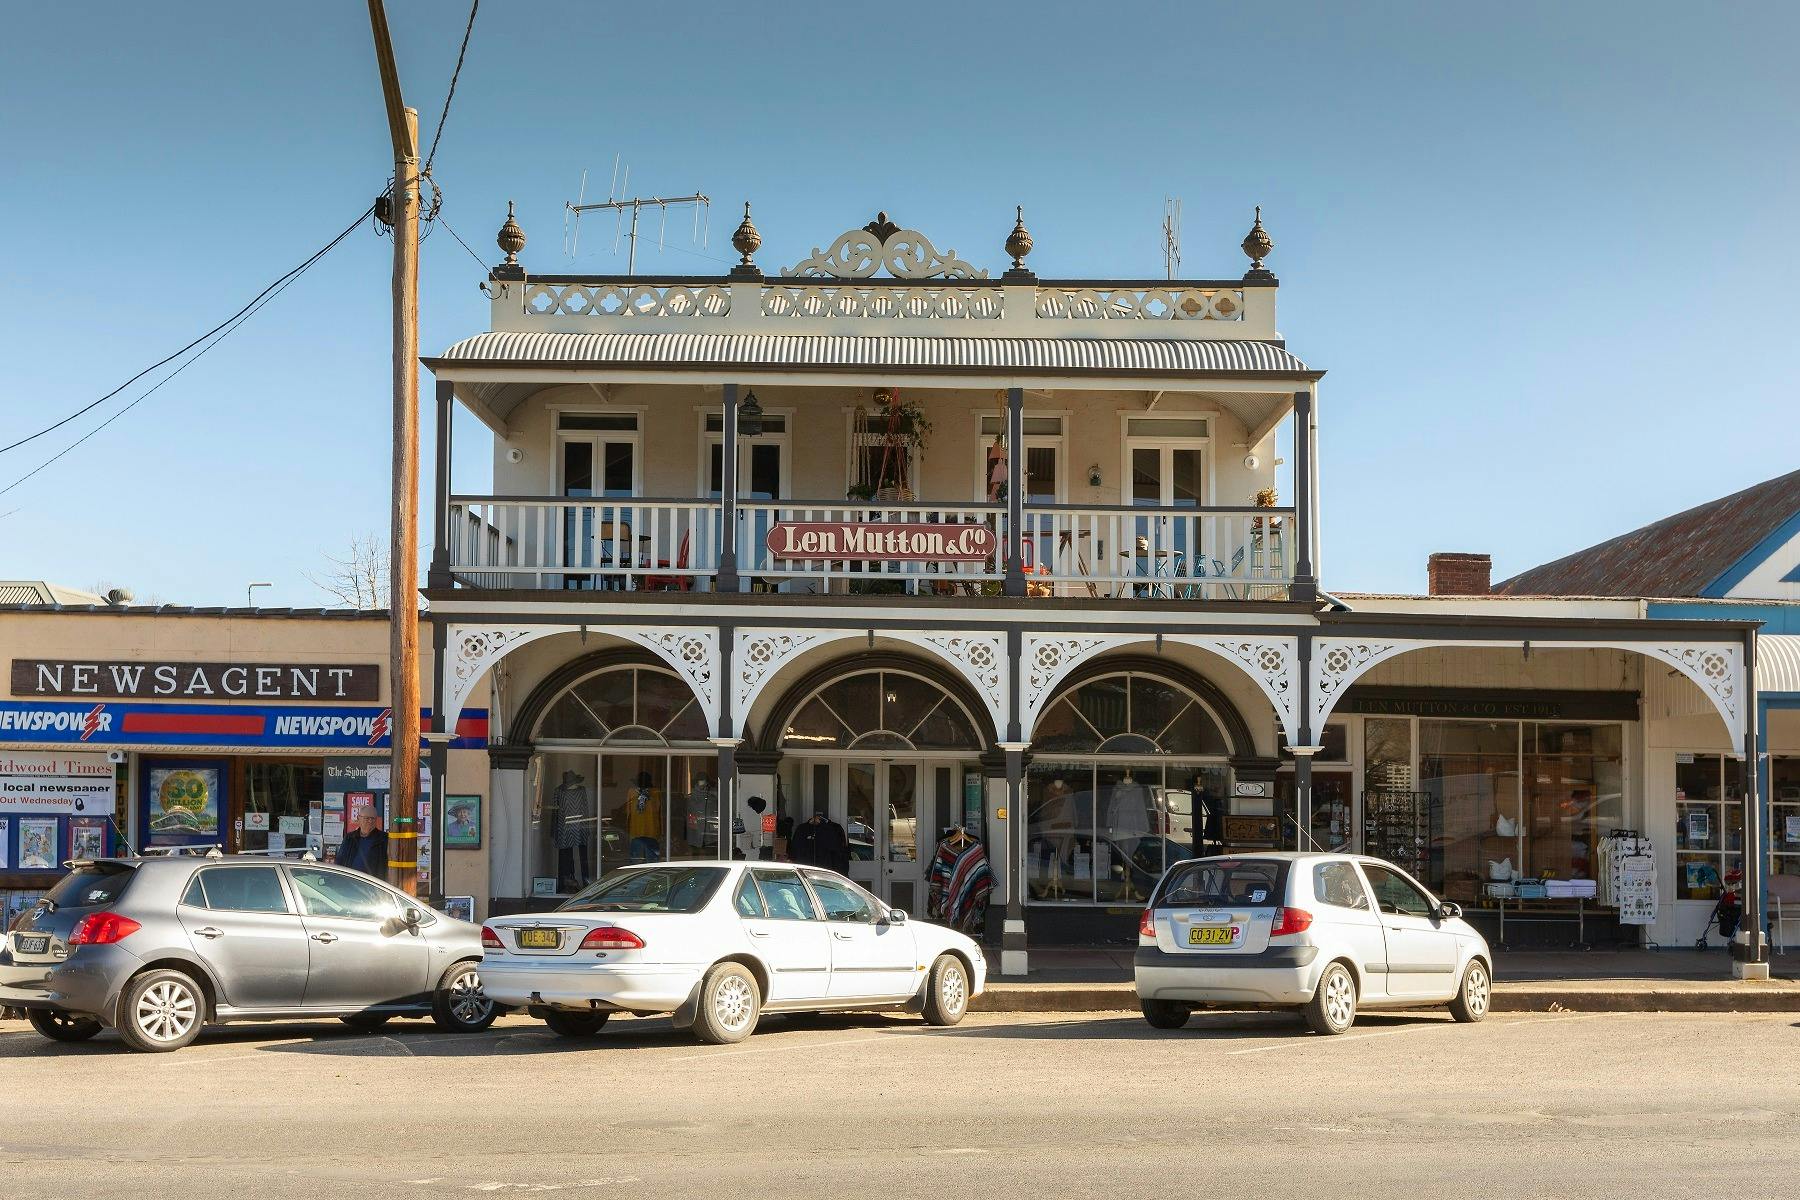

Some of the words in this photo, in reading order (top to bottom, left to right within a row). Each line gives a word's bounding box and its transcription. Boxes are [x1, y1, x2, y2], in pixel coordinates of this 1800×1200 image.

[782, 526, 839, 554] Len
[841, 526, 944, 555] Mutton
[36, 663, 353, 698] NEWSAGENT
[1358, 701, 1389, 713] LEN
[1394, 702, 1457, 713] MUTTON
[1473, 703, 1497, 714] CO
[64, 760, 112, 774] Times
[328, 765, 343, 777] The
[3, 783, 35, 792] local
[167, 778, 204, 799] 30
[20, 797, 73, 807] Wednesday
[166, 799, 203, 807] MILLION
[351, 796, 370, 806] SAVE
